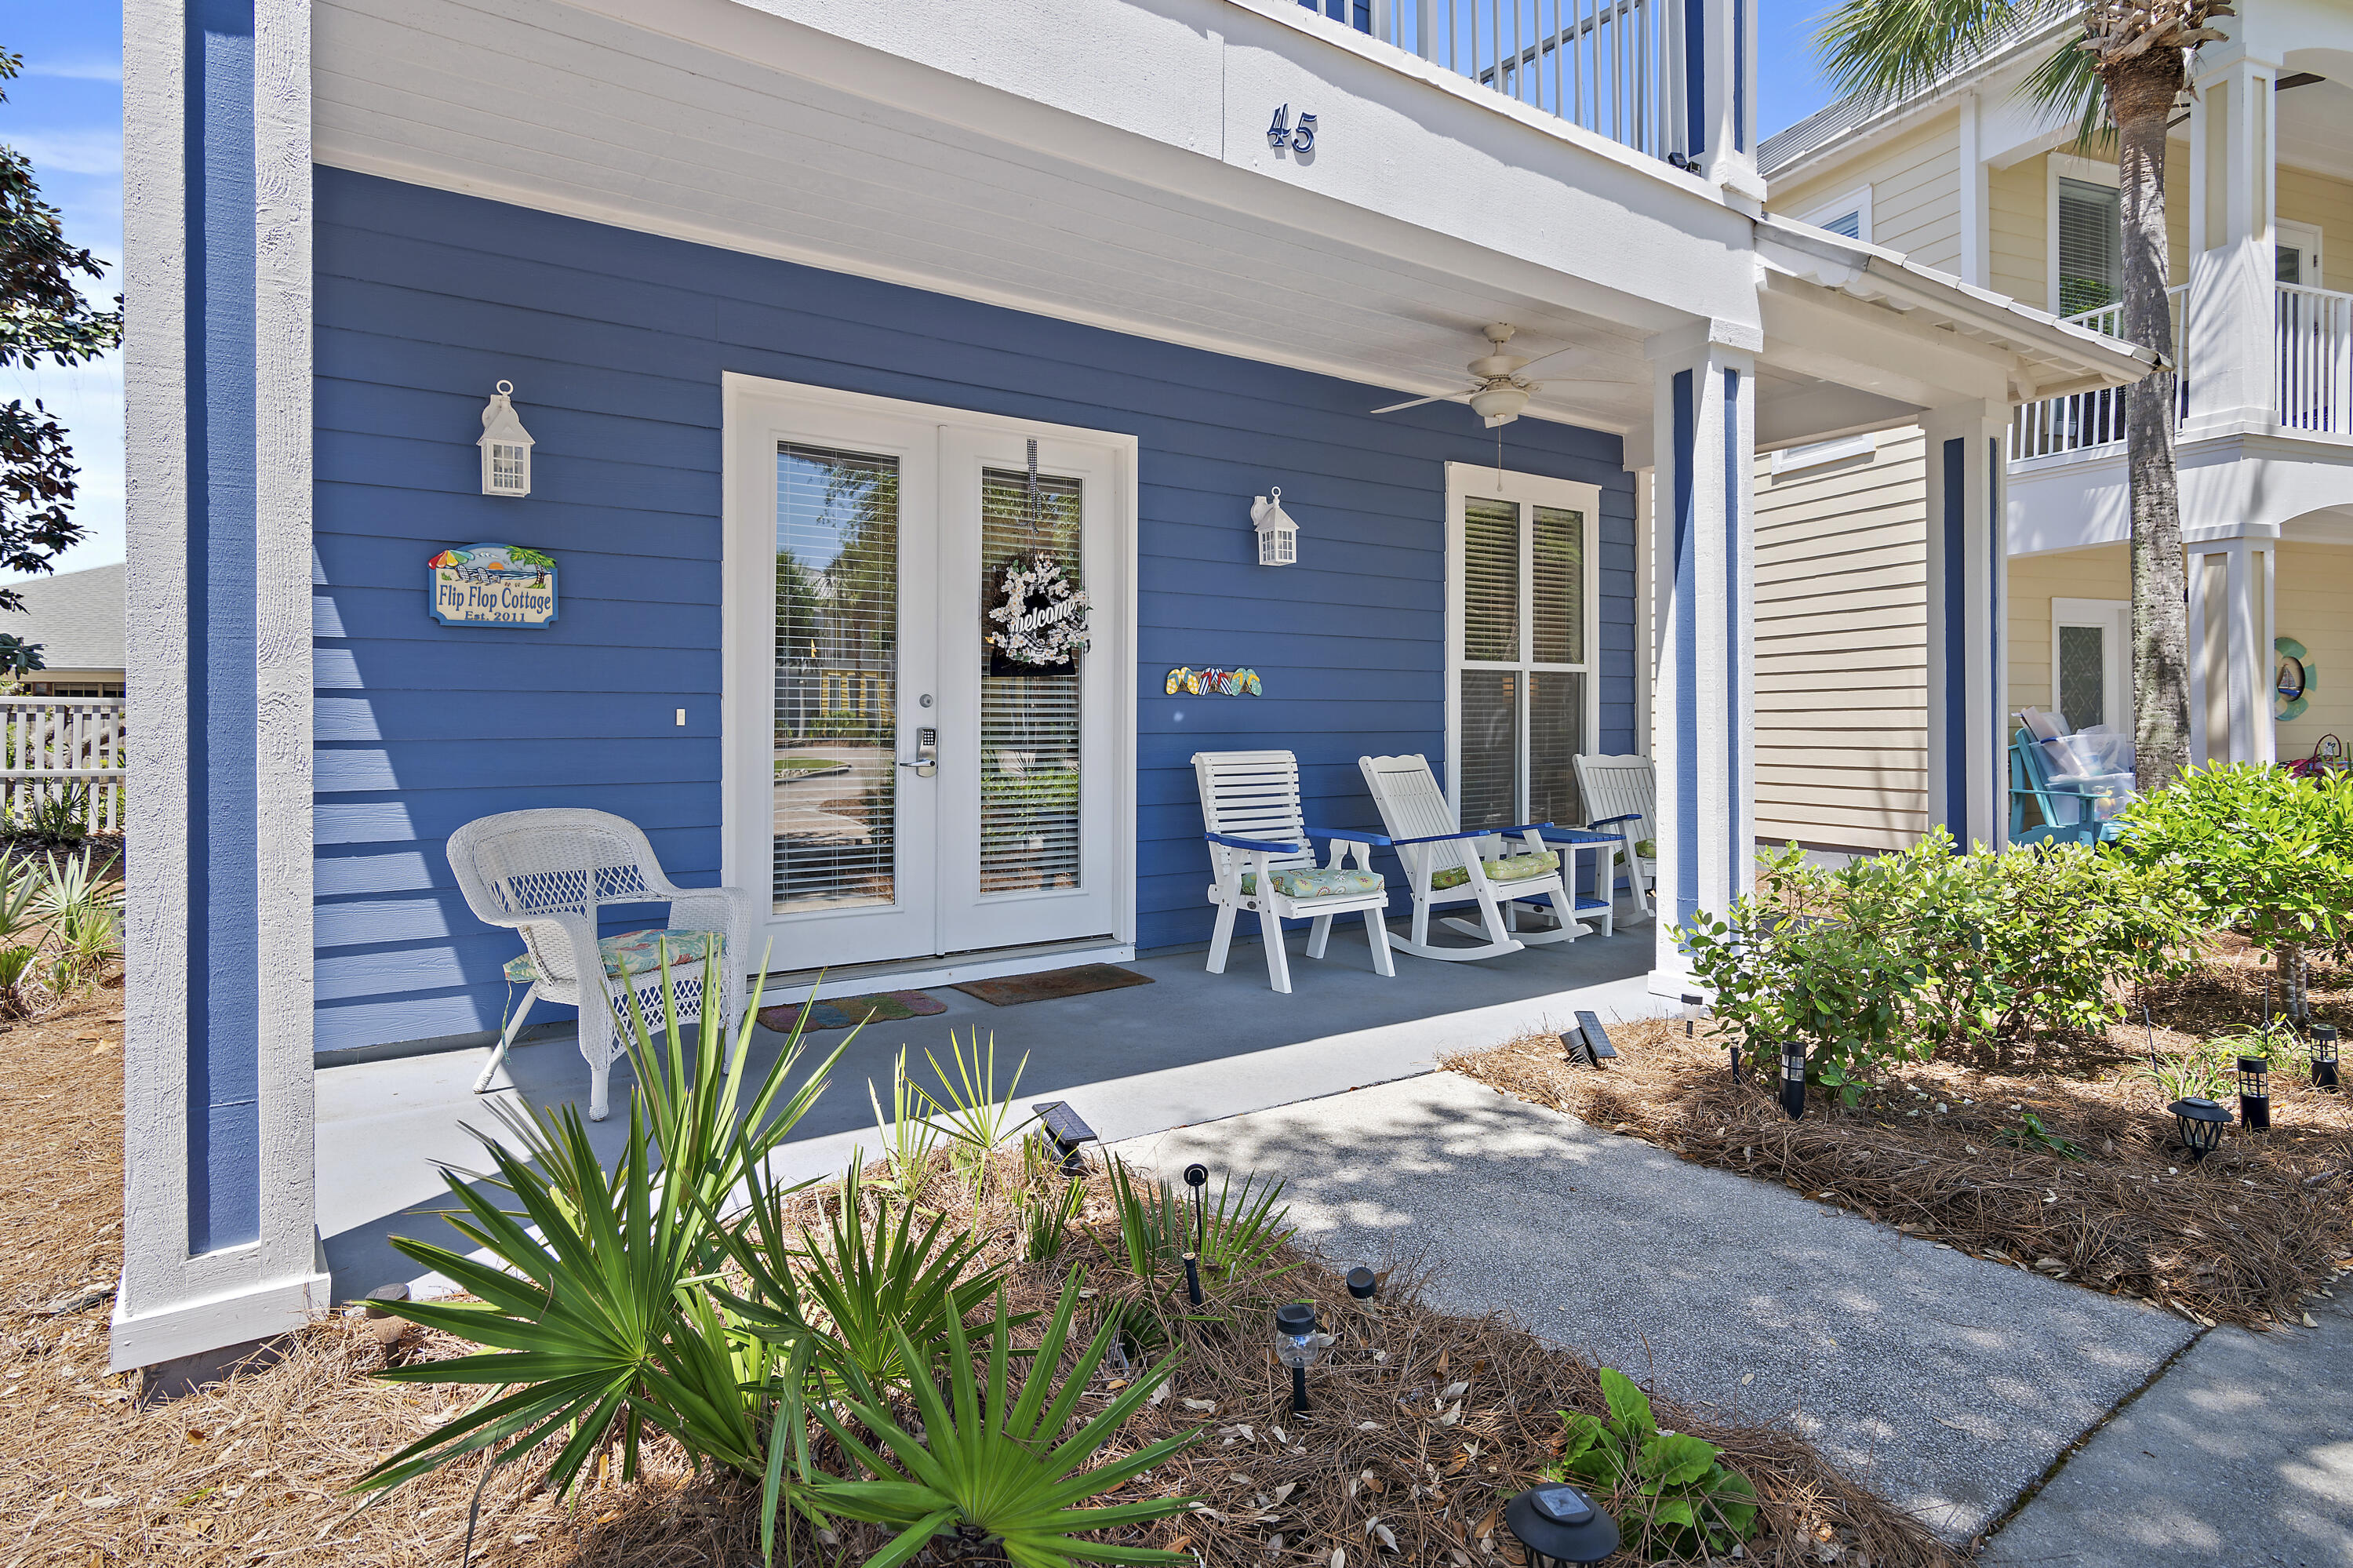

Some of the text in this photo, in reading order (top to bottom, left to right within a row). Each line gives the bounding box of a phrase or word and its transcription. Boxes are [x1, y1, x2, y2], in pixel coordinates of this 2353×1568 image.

[1267, 104, 1317, 153] 45
[438, 584, 551, 614] Flip Flop Cottage
[464, 611, 526, 621] Est. 2011
